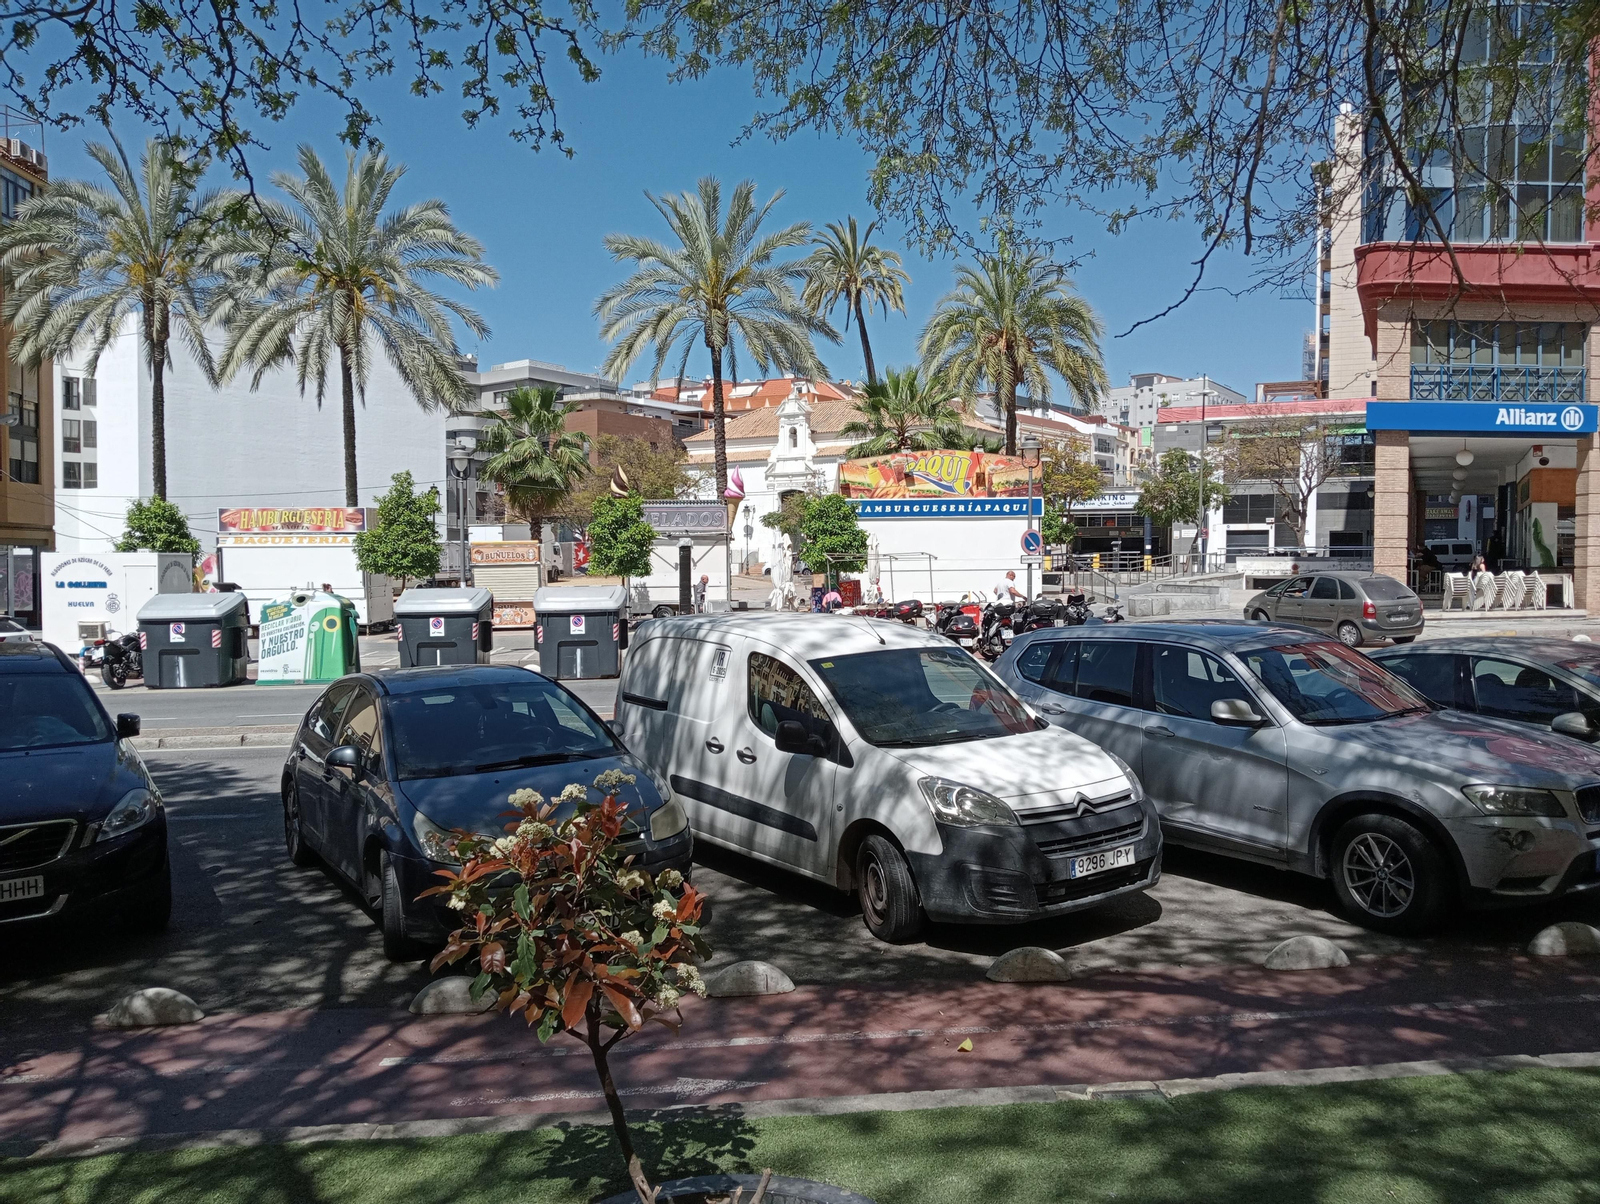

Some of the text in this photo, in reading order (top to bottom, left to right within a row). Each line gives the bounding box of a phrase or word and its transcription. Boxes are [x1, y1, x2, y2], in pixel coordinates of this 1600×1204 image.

[1495, 408, 1557, 426] Allianz
[905, 455, 972, 495] PAQUI
[240, 510, 345, 529] HAMBURGUESERIA
[233, 536, 350, 545] BAGUETERIA
[485, 550, 525, 560] BUÑUELOS
[261, 619, 285, 631] RECICLAR
[261, 628, 304, 649] Y NUESTRO
[261, 640, 298, 660] ORGULLO.
[1078, 848, 1131, 873] 9296 JPY
[0, 879, 38, 899] HHH
